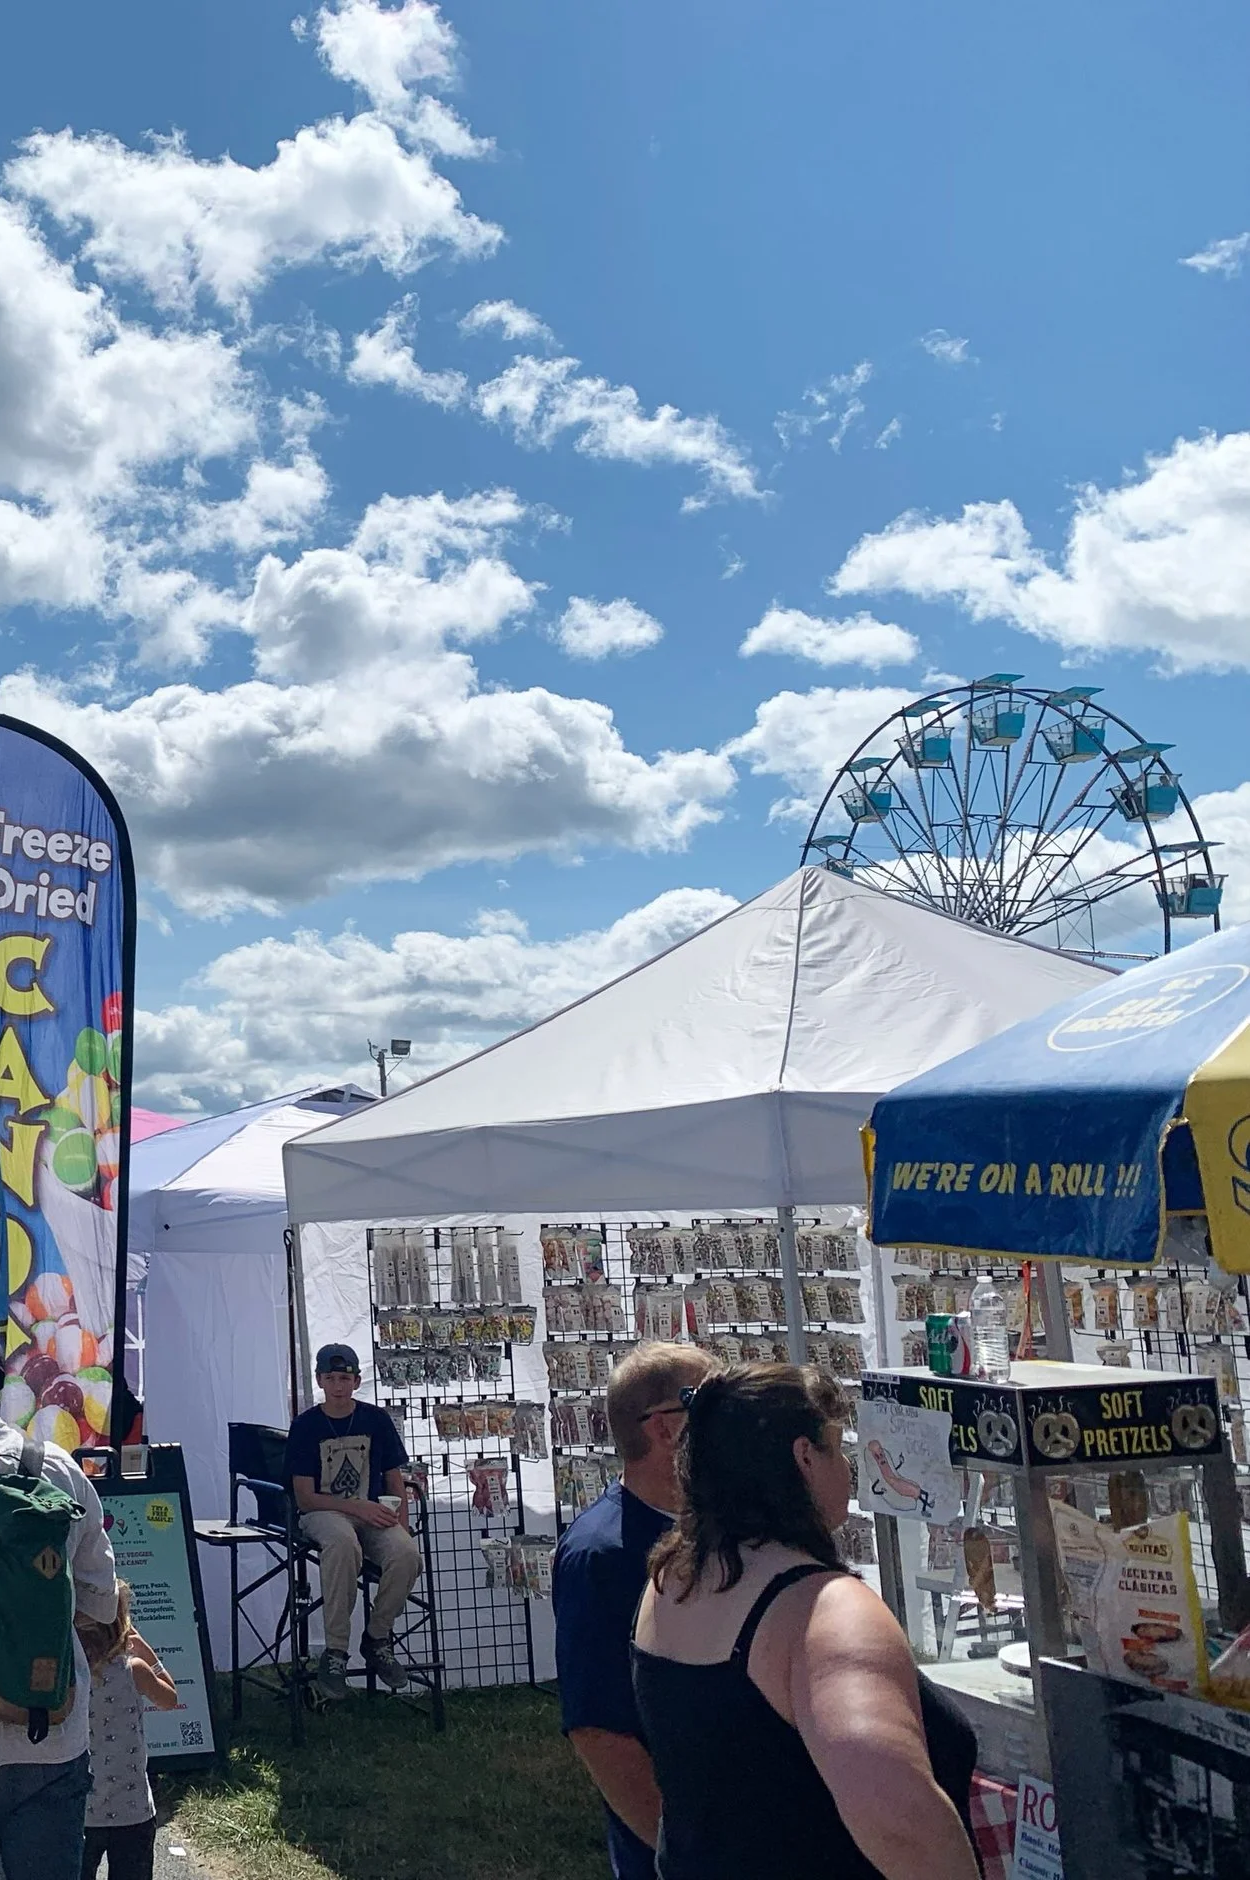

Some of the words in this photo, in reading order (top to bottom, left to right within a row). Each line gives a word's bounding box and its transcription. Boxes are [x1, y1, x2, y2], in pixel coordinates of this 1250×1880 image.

[892, 1162, 974, 1194] WE'RE
[979, 1163, 1017, 1195] ON
[1025, 1163, 1043, 1196] A
[1049, 1163, 1105, 1198] ROLL
[1114, 1164, 1142, 1198] !!!
[919, 1386, 954, 1414] SOFT
[1100, 1390, 1143, 1420] SOFT
[1084, 1424, 1173, 1457] PRETZELS
